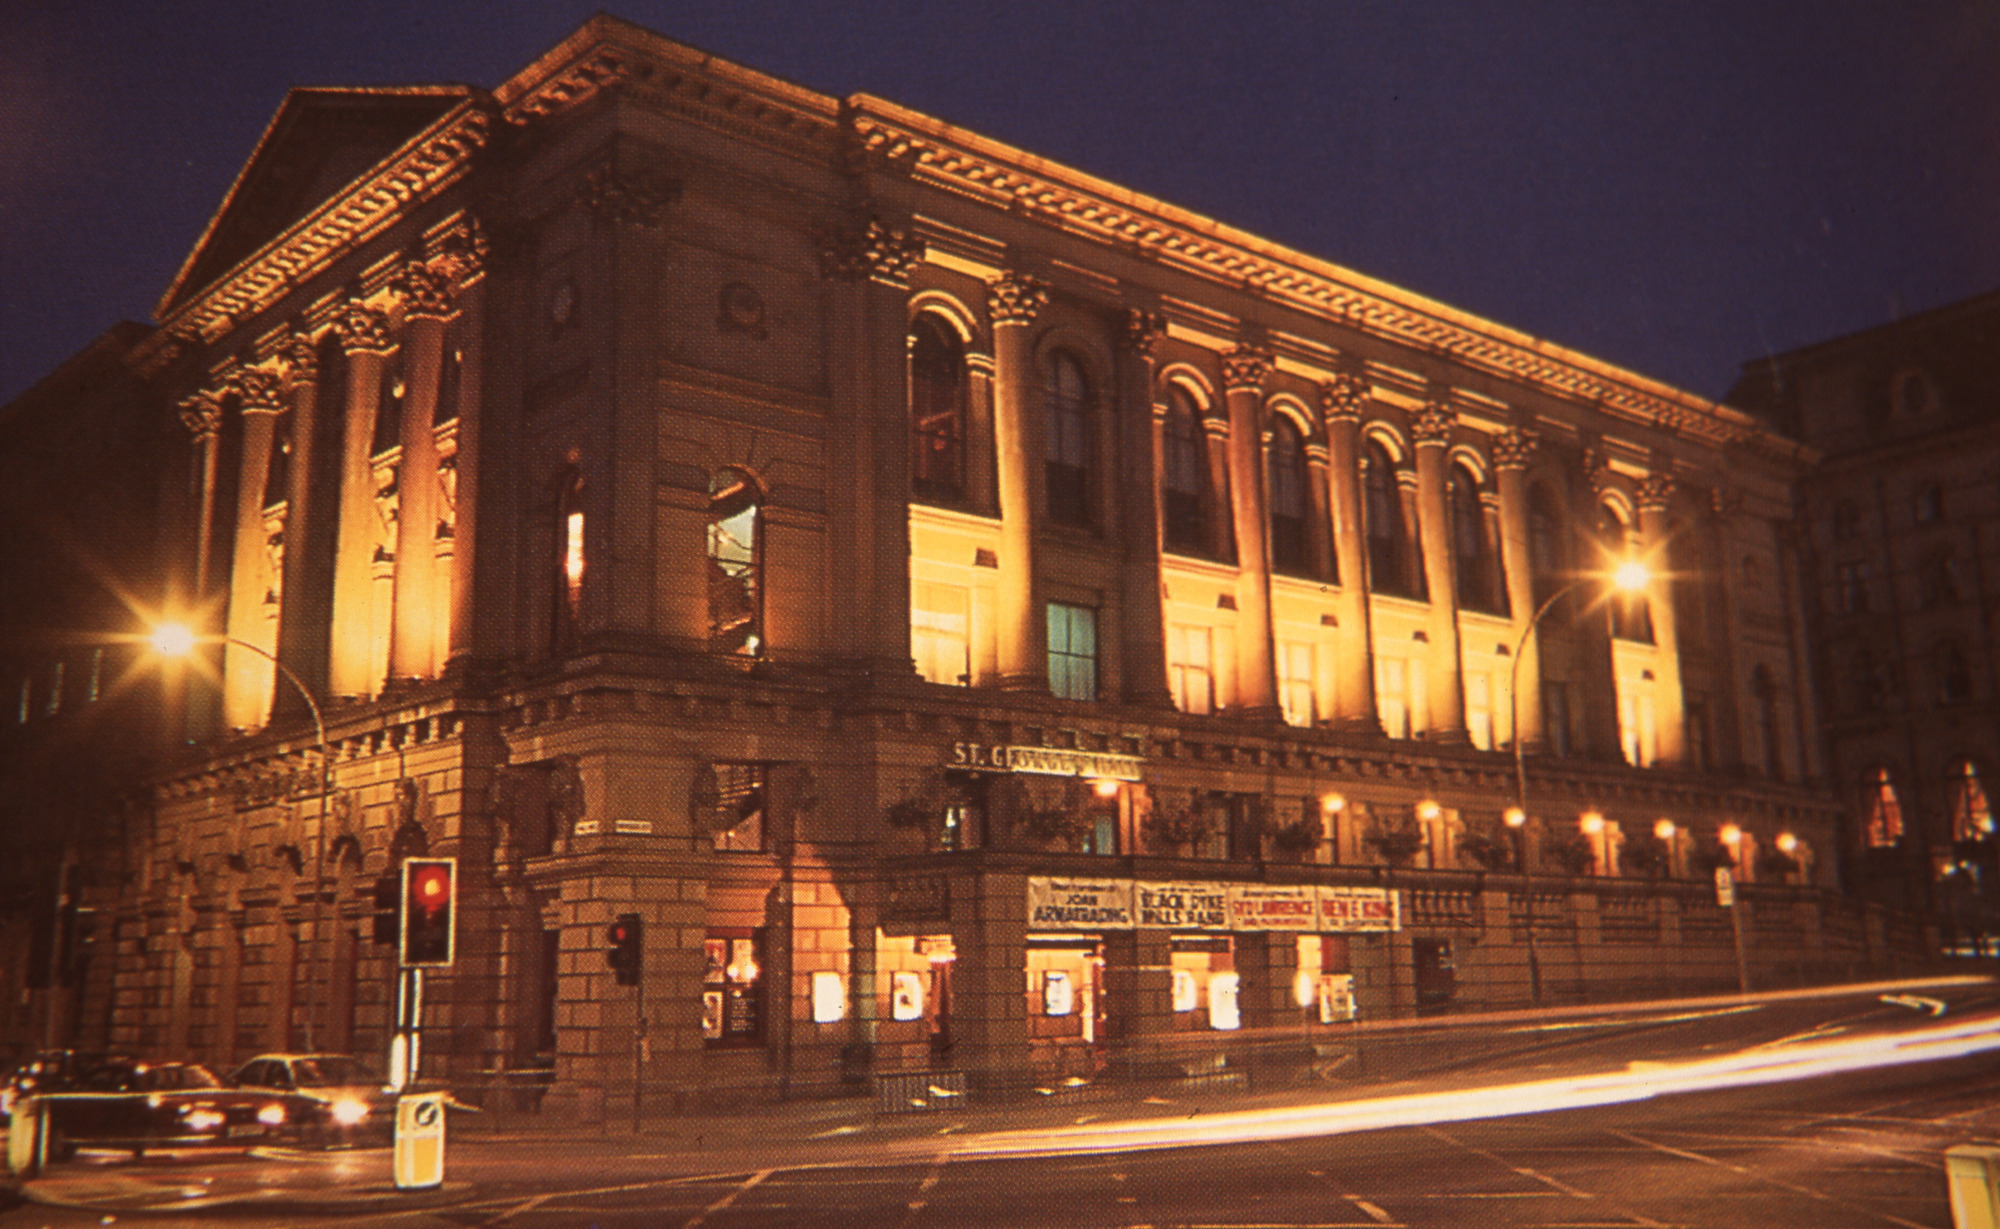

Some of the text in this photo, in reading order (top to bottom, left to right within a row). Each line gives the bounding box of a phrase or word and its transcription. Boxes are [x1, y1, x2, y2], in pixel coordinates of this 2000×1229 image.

[953, 742, 985, 766] ST.
[1066, 894, 1098, 906] JOAN
[1140, 893, 1183, 909] BLACK
[1191, 894, 1225, 910] DYKE
[1033, 906, 1129, 923] ARMATRADING
[1140, 909, 1181, 924] MILLS
